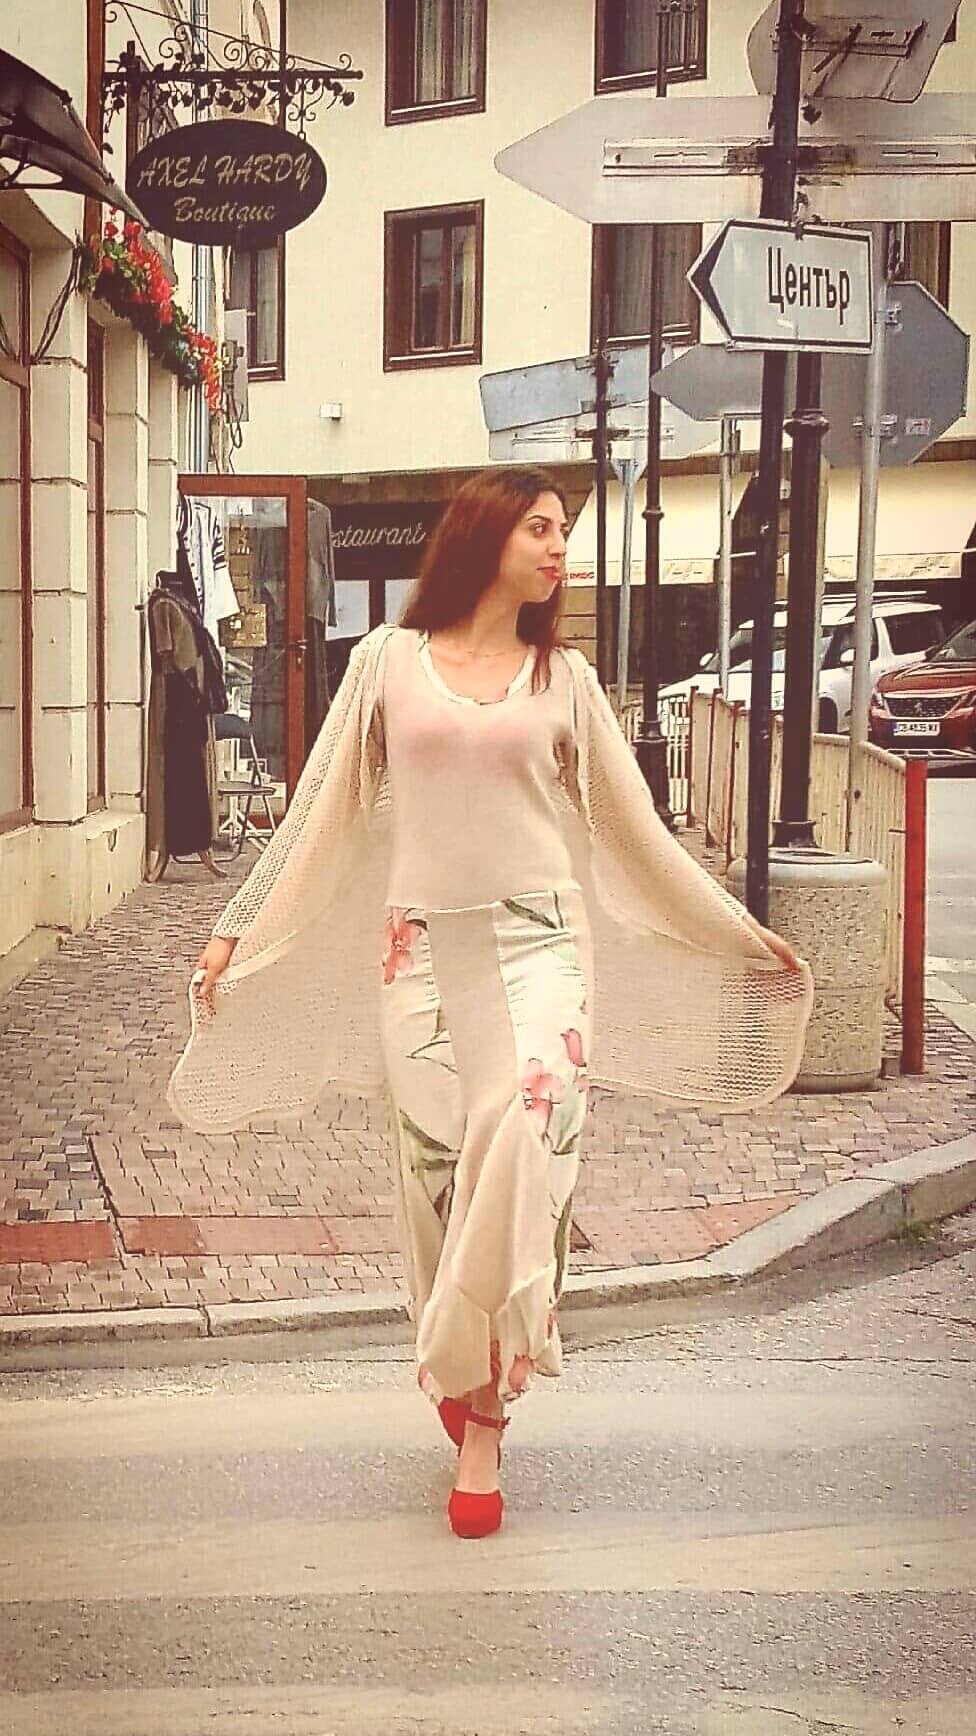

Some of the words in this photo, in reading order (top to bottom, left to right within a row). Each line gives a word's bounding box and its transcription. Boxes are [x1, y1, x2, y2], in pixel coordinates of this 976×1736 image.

[136, 155, 207, 188] AXEL
[214, 153, 312, 191] HARDY
[173, 196, 276, 229] Boutique
[768, 246, 850, 325] Център
[331, 522, 427, 548] staurant
